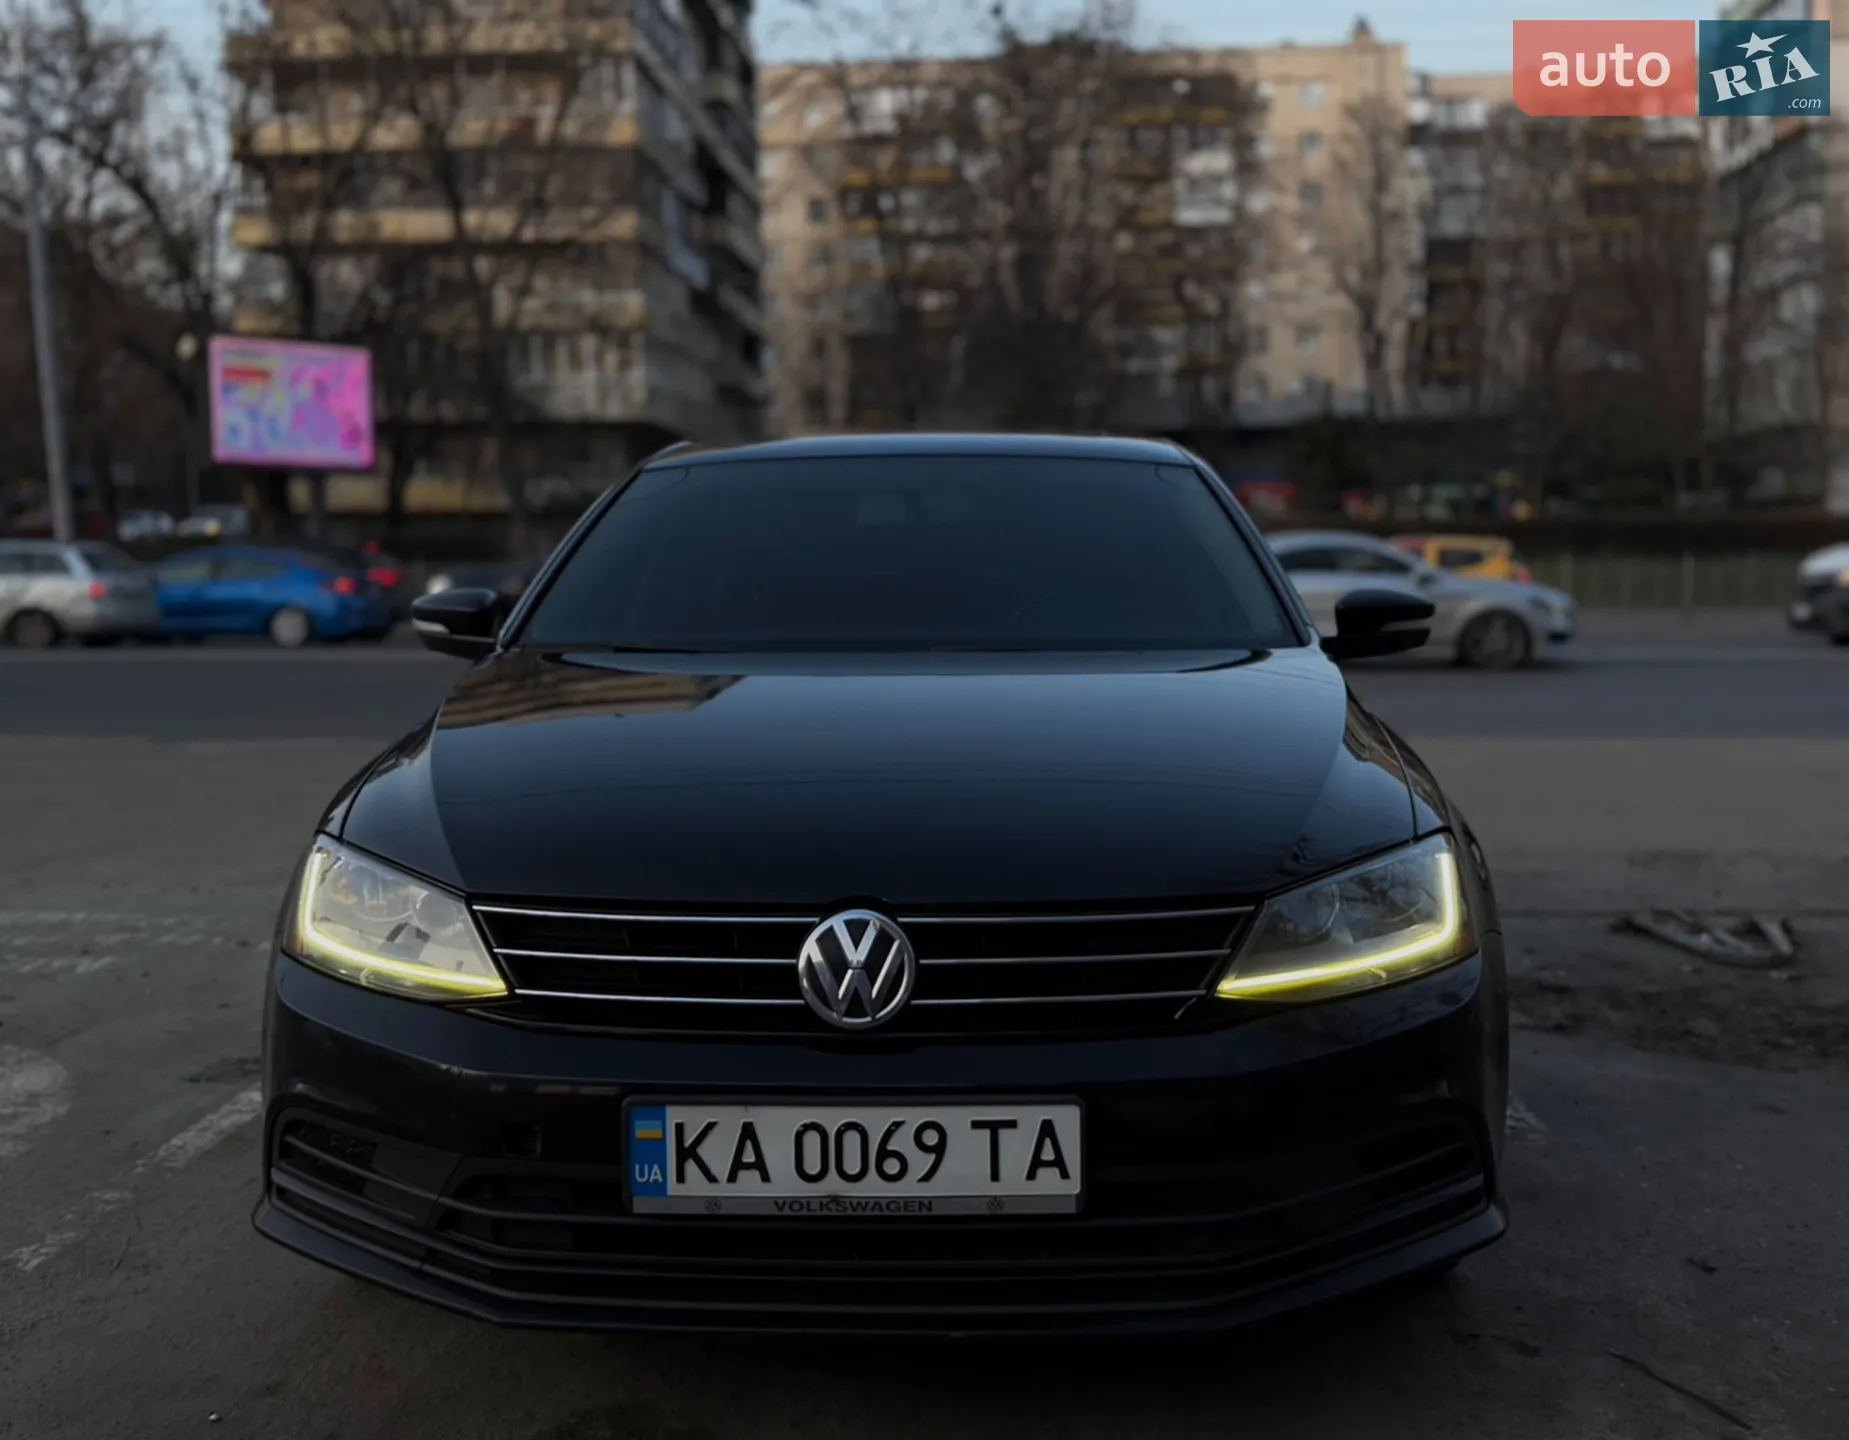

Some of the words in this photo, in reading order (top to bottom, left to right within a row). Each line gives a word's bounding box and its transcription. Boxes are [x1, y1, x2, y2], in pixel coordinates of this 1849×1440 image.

[802, 913, 911, 1025] VW
[673, 1119, 772, 1184] KA
[793, 1119, 948, 1184] 0069
[970, 1118, 1072, 1182] TA
[635, 1163, 664, 1184] UA
[773, 1200, 933, 1213] VOLKSWAGEN
